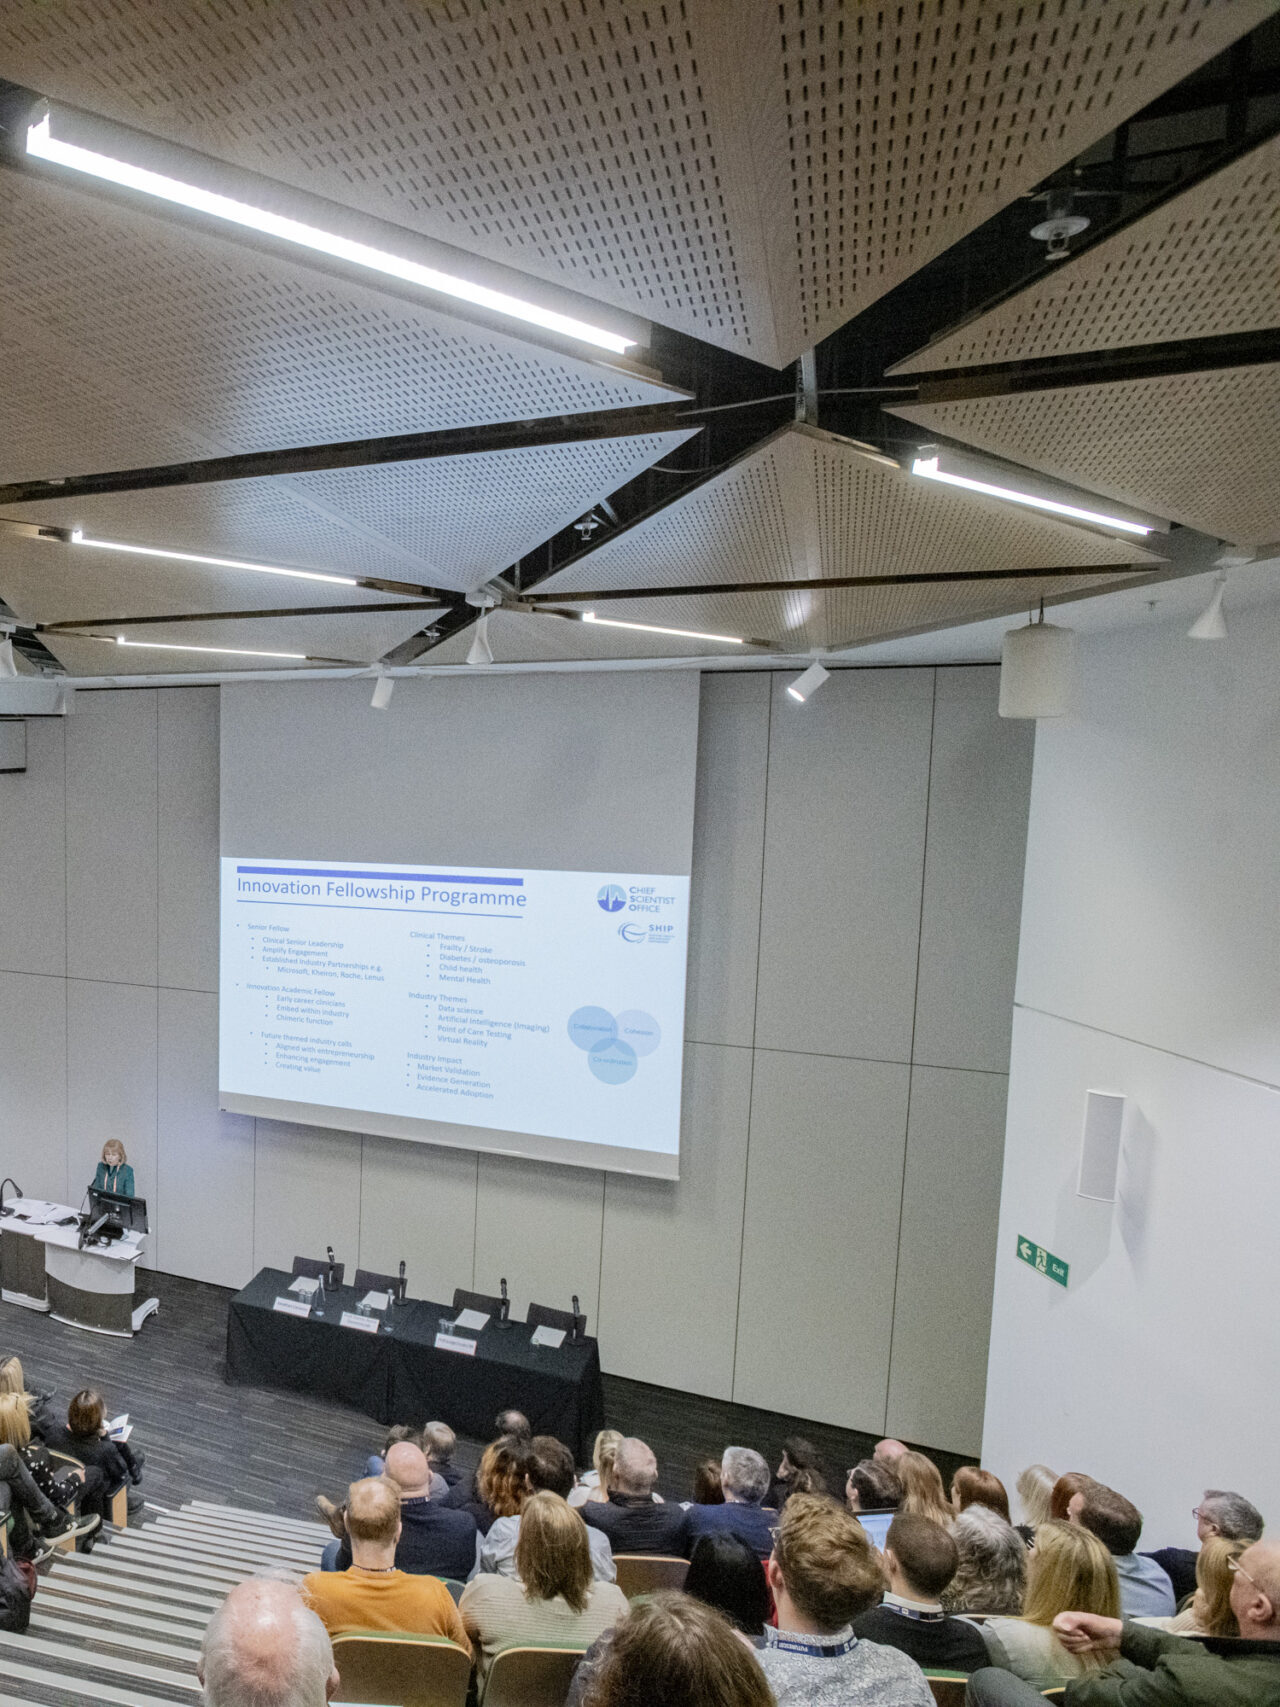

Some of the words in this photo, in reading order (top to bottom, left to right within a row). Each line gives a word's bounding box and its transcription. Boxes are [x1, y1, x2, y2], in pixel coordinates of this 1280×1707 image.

[237, 878, 320, 896] Innovation
[326, 881, 415, 903] Fellowship
[421, 886, 527, 907] Programme
[629, 886, 656, 894] CHIEF
[630, 895, 676, 904] SCIENTIST
[628, 904, 660, 913] OFFICE
[248, 923, 267, 931] Senior
[269, 924, 289, 932] Fellow
[648, 924, 674, 932] SHIP
[410, 931, 435, 939] Clinical
[437, 933, 465, 941] Themes
[287, 938, 306, 946] Senior
[308, 940, 344, 949] Leadership
[440, 943, 462, 952] Frailty
[469, 945, 493, 953] Stroke
[262, 946, 286, 955] Amplify
[288, 948, 328, 957] Engagement
[262, 956, 298, 965] Established
[299, 958, 326, 967] Industry
[328, 961, 368, 971] Partnerships
[440, 953, 471, 962] Diabetes
[478, 957, 526, 967] osteoporosis
[439, 963, 458, 972] Child
[460, 965, 483, 974] health
[439, 974, 465, 983] Mental
[466, 976, 491, 985] Health
[246, 983, 280, 992] Innovation
[281, 985, 312, 995] Academic
[314, 988, 335, 997] Fellow
[277, 994, 293, 1003] Early
[294, 997, 314, 1005] career
[315, 999, 345, 1007] clinicians
[408, 992, 438, 1002] Industry
[439, 994, 468, 1003] Themes
[276, 1004, 299, 1013] Embed
[301, 1006, 320, 1015] within
[322, 1009, 350, 1018] industry
[438, 1004, 455, 1013] Data
[457, 1007, 484, 1015] science
[276, 1014, 304, 1023] Chimeric
[306, 1017, 333, 1026] function
[438, 1015, 468, 1024] Artificial
[470, 1017, 512, 1029] Intelligence
[514, 1022, 550, 1033] (Imaging)
[438, 1025, 456, 1033] Point
[467, 1027, 484, 1035] Care
[486, 1029, 512, 1040] Testing
[261, 1031, 282, 1040] Future
[283, 1033, 308, 1043] themed
[310, 1037, 336, 1047] industry
[338, 1040, 352, 1048] calls
[438, 1035, 461, 1044] Virtual
[463, 1038, 488, 1048] Reality
[276, 1042, 300, 1052] Aligned
[301, 1045, 316, 1053] with
[317, 1047, 375, 1061] entrepreneurship
[276, 1052, 309, 1063] Enhancing
[310, 1056, 351, 1067] engagement
[407, 1052, 436, 1062] Industry
[438, 1055, 462, 1065] Impact
[276, 1061, 302, 1072] Creating
[304, 1065, 321, 1073] value
[417, 1063, 443, 1072] Market
[444, 1066, 480, 1076] Validation
[417, 1073, 448, 1083] Evidence
[450, 1077, 491, 1088] Generation
[416, 1083, 458, 1095] Accelerated
[460, 1088, 494, 1099] Adoption
